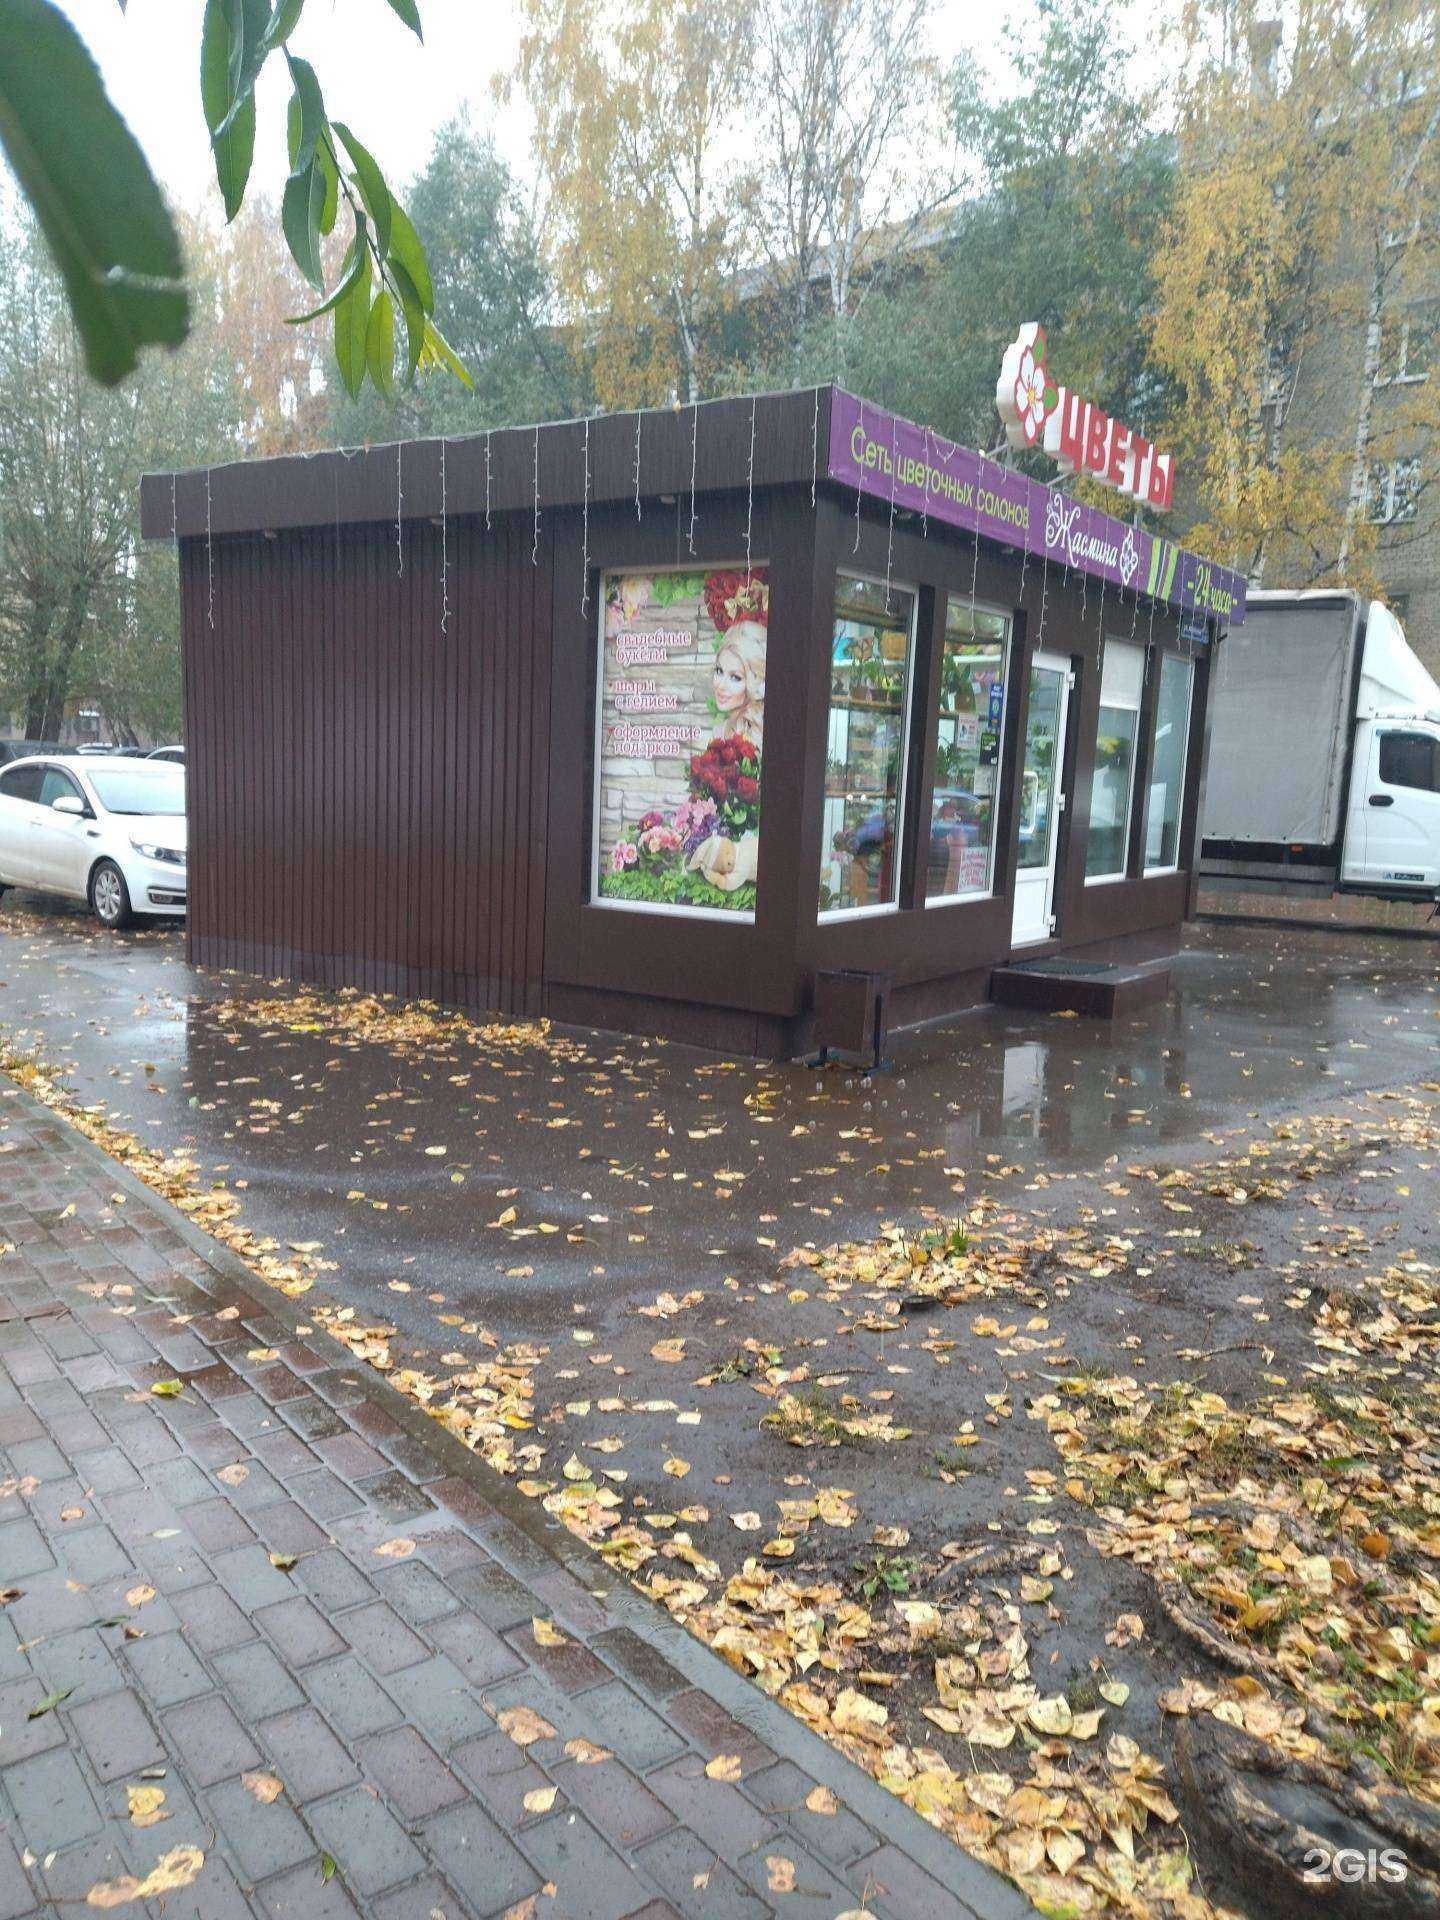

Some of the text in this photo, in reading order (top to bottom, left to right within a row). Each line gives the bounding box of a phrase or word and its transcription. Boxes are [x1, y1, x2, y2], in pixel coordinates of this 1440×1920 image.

[1056, 386, 1177, 513] ЦВЕТЫ
[851, 426, 1030, 529] Сеть цветочных салонов
[1045, 493, 1118, 568] Жасмина
[616, 627, 692, 648] свадебные
[615, 647, 667, 668] букеты
[615, 679, 655, 696] шары
[615, 694, 678, 710] с гелием
[614, 722, 701, 743] оформление
